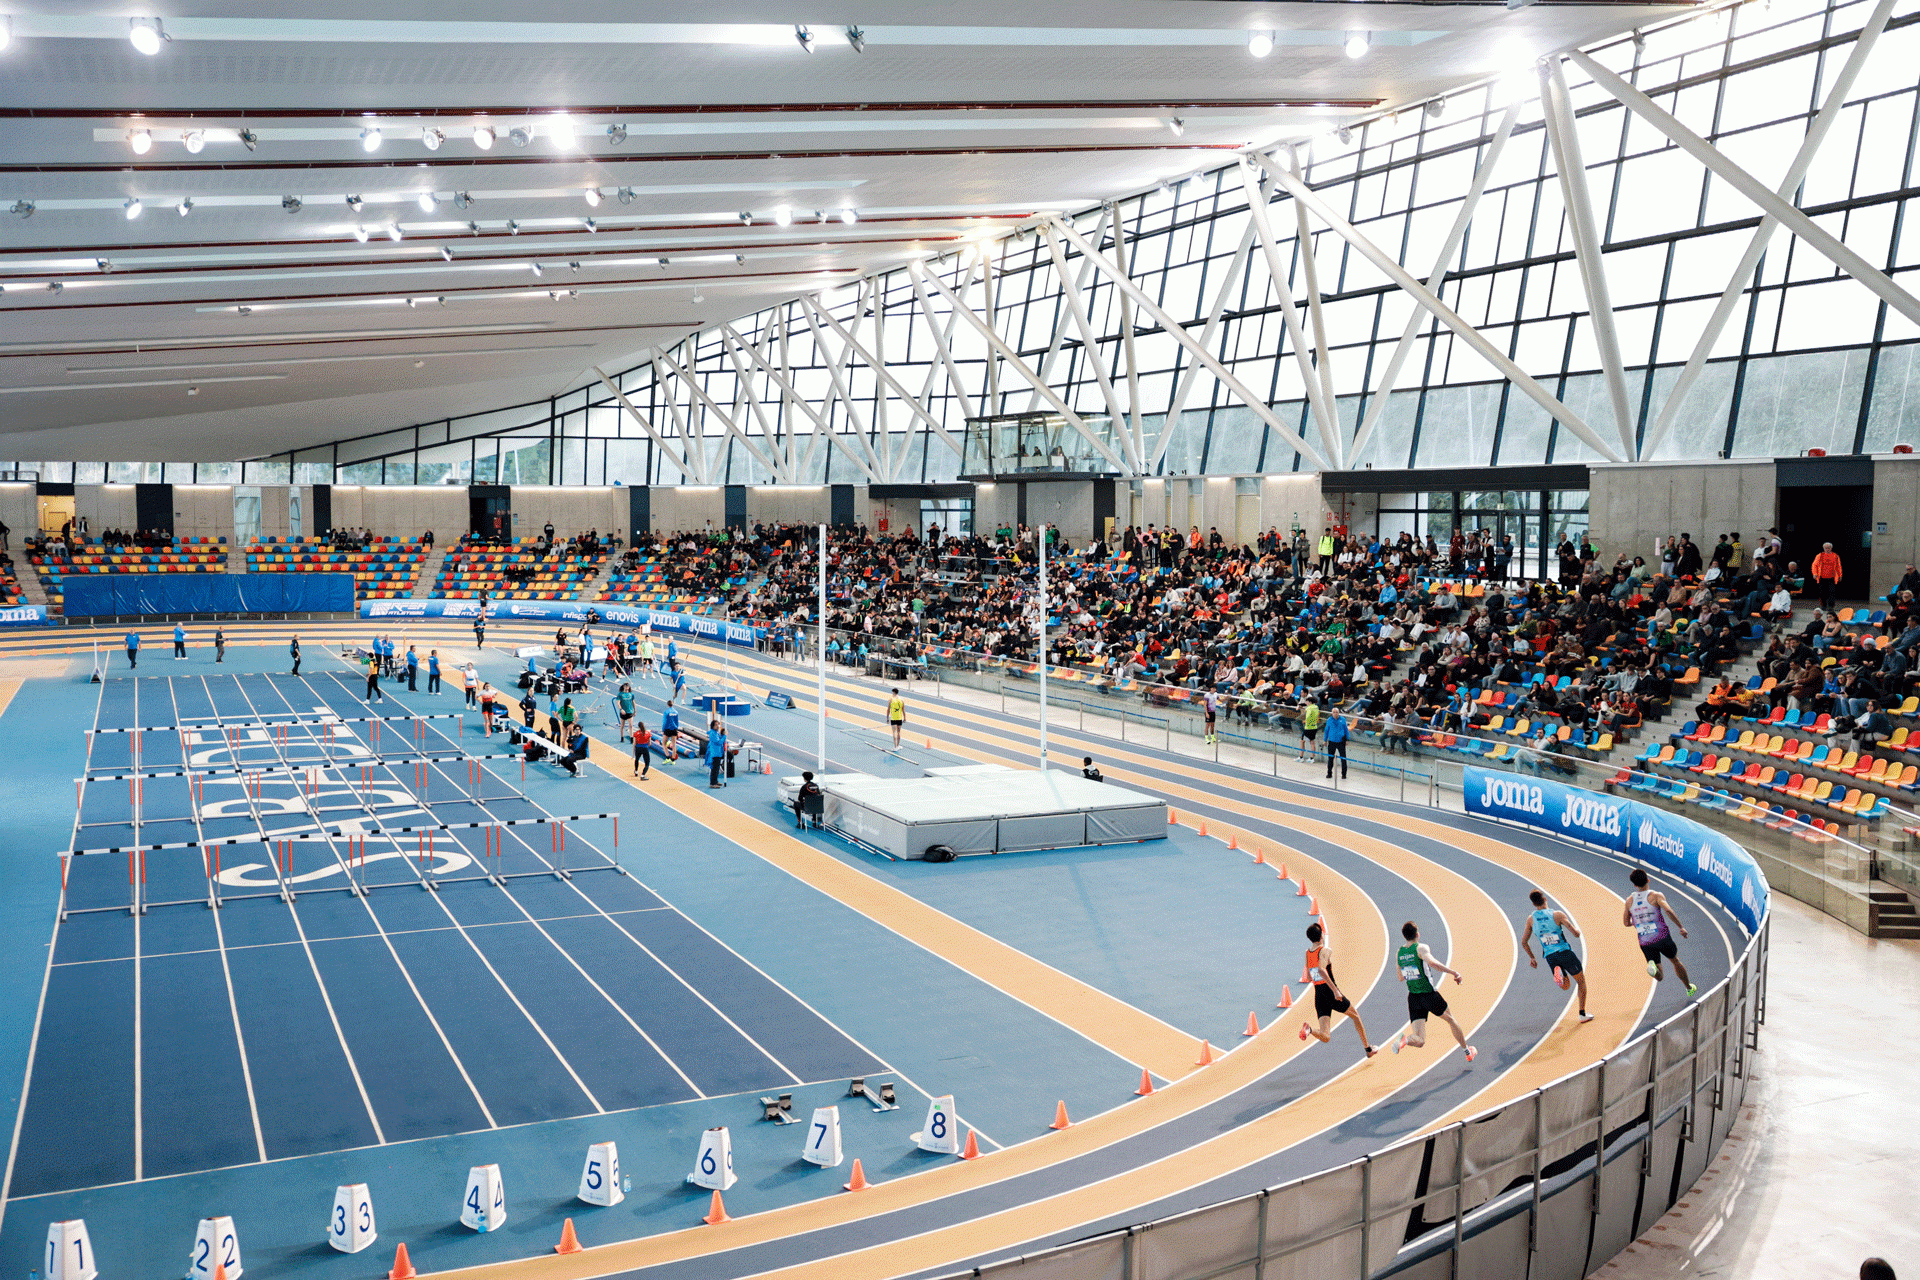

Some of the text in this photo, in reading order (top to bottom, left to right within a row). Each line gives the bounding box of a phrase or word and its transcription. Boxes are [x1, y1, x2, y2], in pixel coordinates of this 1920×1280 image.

[0, 608, 40, 622] oma
[606, 610, 639, 623] enovis
[647, 612, 681, 628] Joma
[689, 618, 718, 635] Joma
[1481, 777, 1545, 815] Joma
[1561, 794, 1621, 837] Joma
[814, 1122, 828, 1149] 7
[930, 1112, 946, 1138] 8
[586, 1160, 602, 1190] 5
[701, 1147, 716, 1175] 6
[467, 1185, 481, 1214] 4
[494, 1181, 503, 1208] 4
[334, 1205, 346, 1236] 3
[359, 1201, 371, 1233] 3
[49, 1240, 55, 1274] 1
[73, 1238, 83, 1270] 1
[196, 1238, 210, 1273] 2
[221, 1234, 236, 1269] 2
